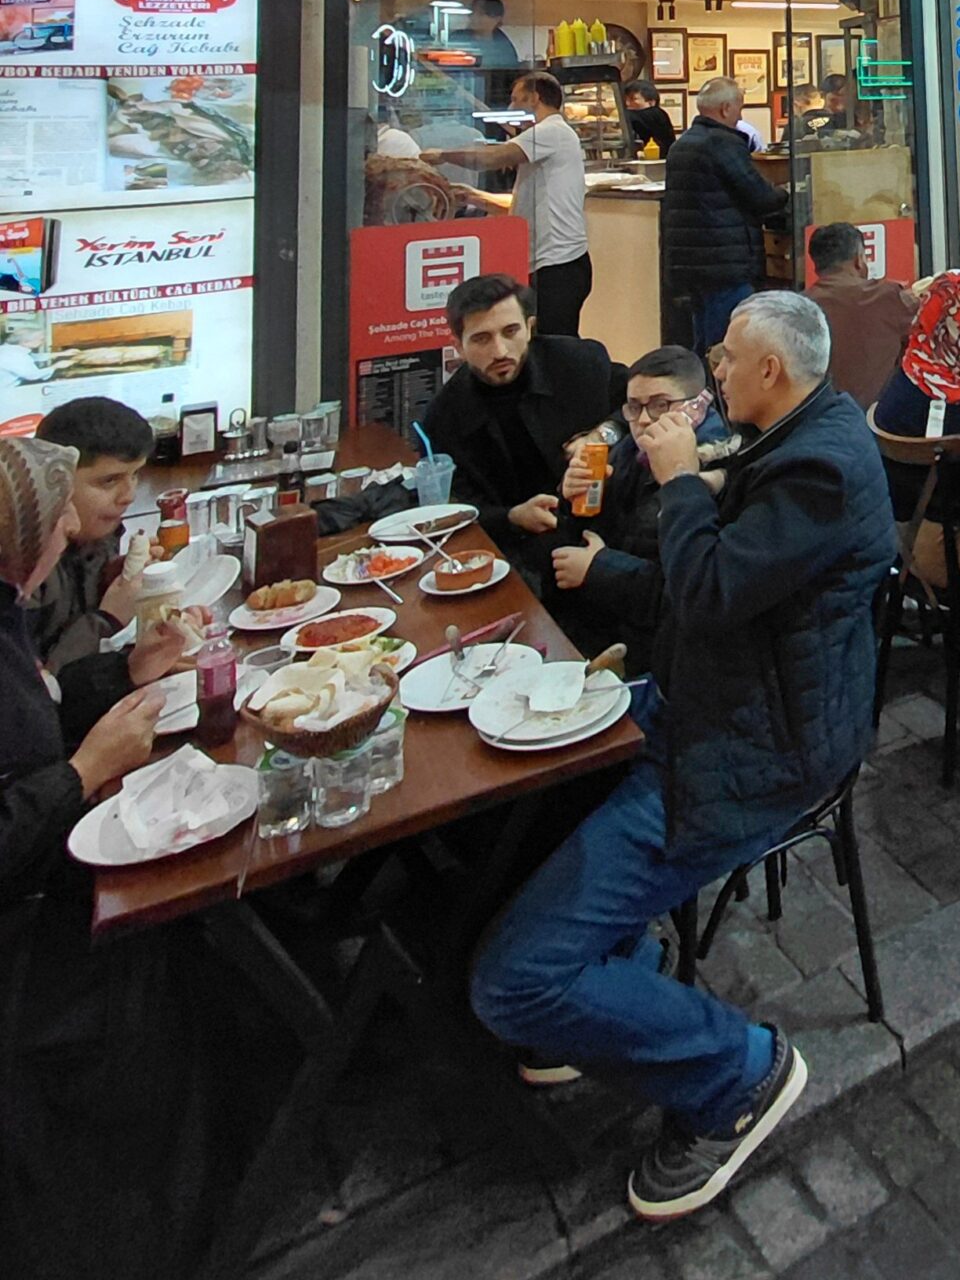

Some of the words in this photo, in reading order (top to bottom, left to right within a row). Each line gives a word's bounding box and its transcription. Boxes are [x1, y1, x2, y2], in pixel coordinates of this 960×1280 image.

[170, 64, 244, 76] YOLLARDA
[40, 294, 90, 310] YEMEK
[196, 278, 243, 293] KEBAP
[429, 315, 448, 326] Keb
[384, 332, 417, 343] Among
[419, 329, 434, 338] The
